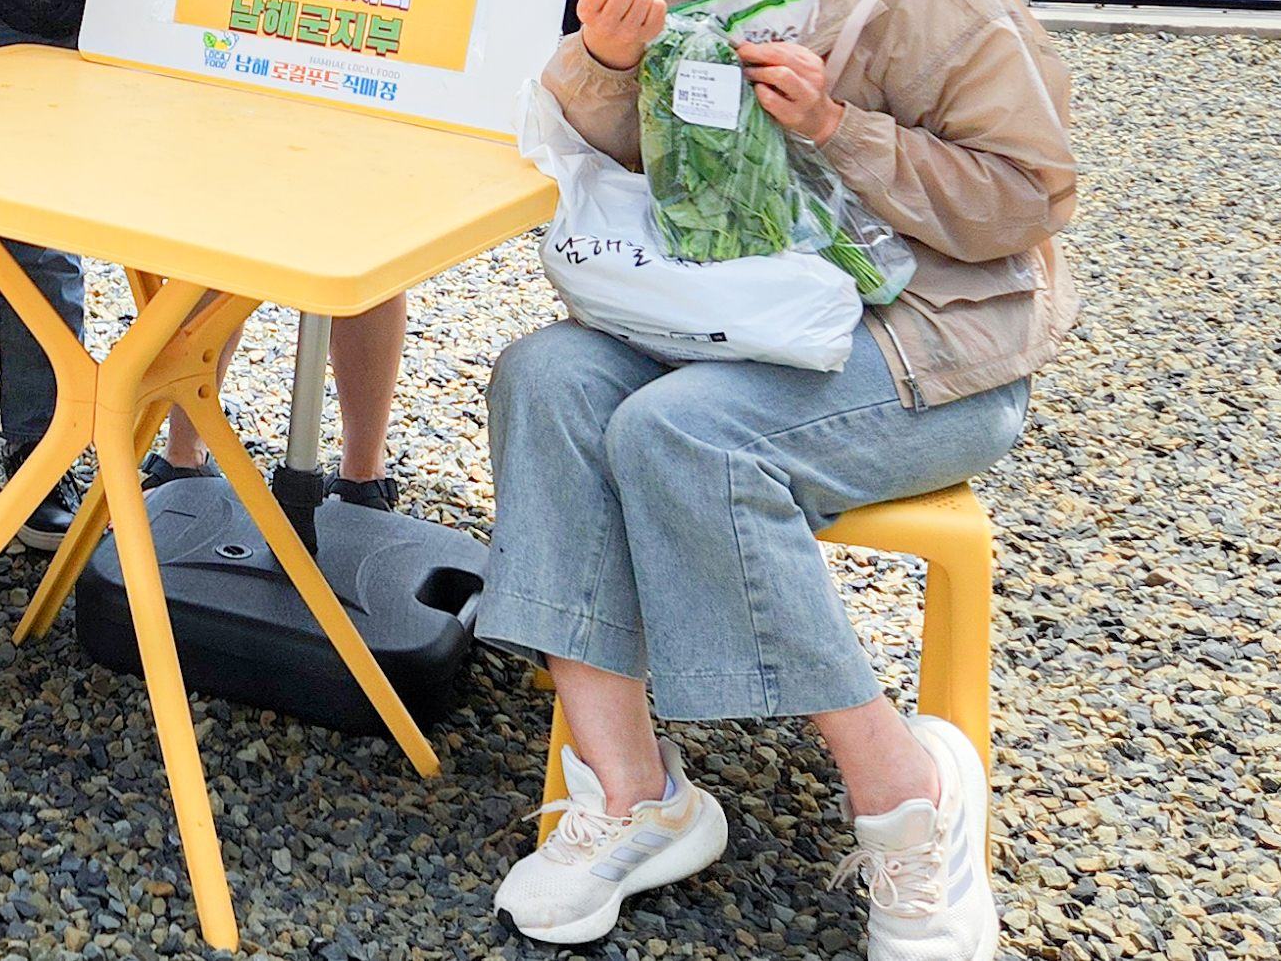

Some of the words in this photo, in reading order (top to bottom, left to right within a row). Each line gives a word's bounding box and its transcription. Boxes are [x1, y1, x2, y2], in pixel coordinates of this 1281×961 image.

[205, 58, 227, 69] FOOD
[309, 56, 347, 70] NAMHAE
[347, 62, 375, 76] LOCAL
[376, 67, 401, 80] FOOD
[235, 54, 270, 76] 남해
[271, 60, 340, 90] 로컬푸드
[341, 73, 398, 101] 직매장
